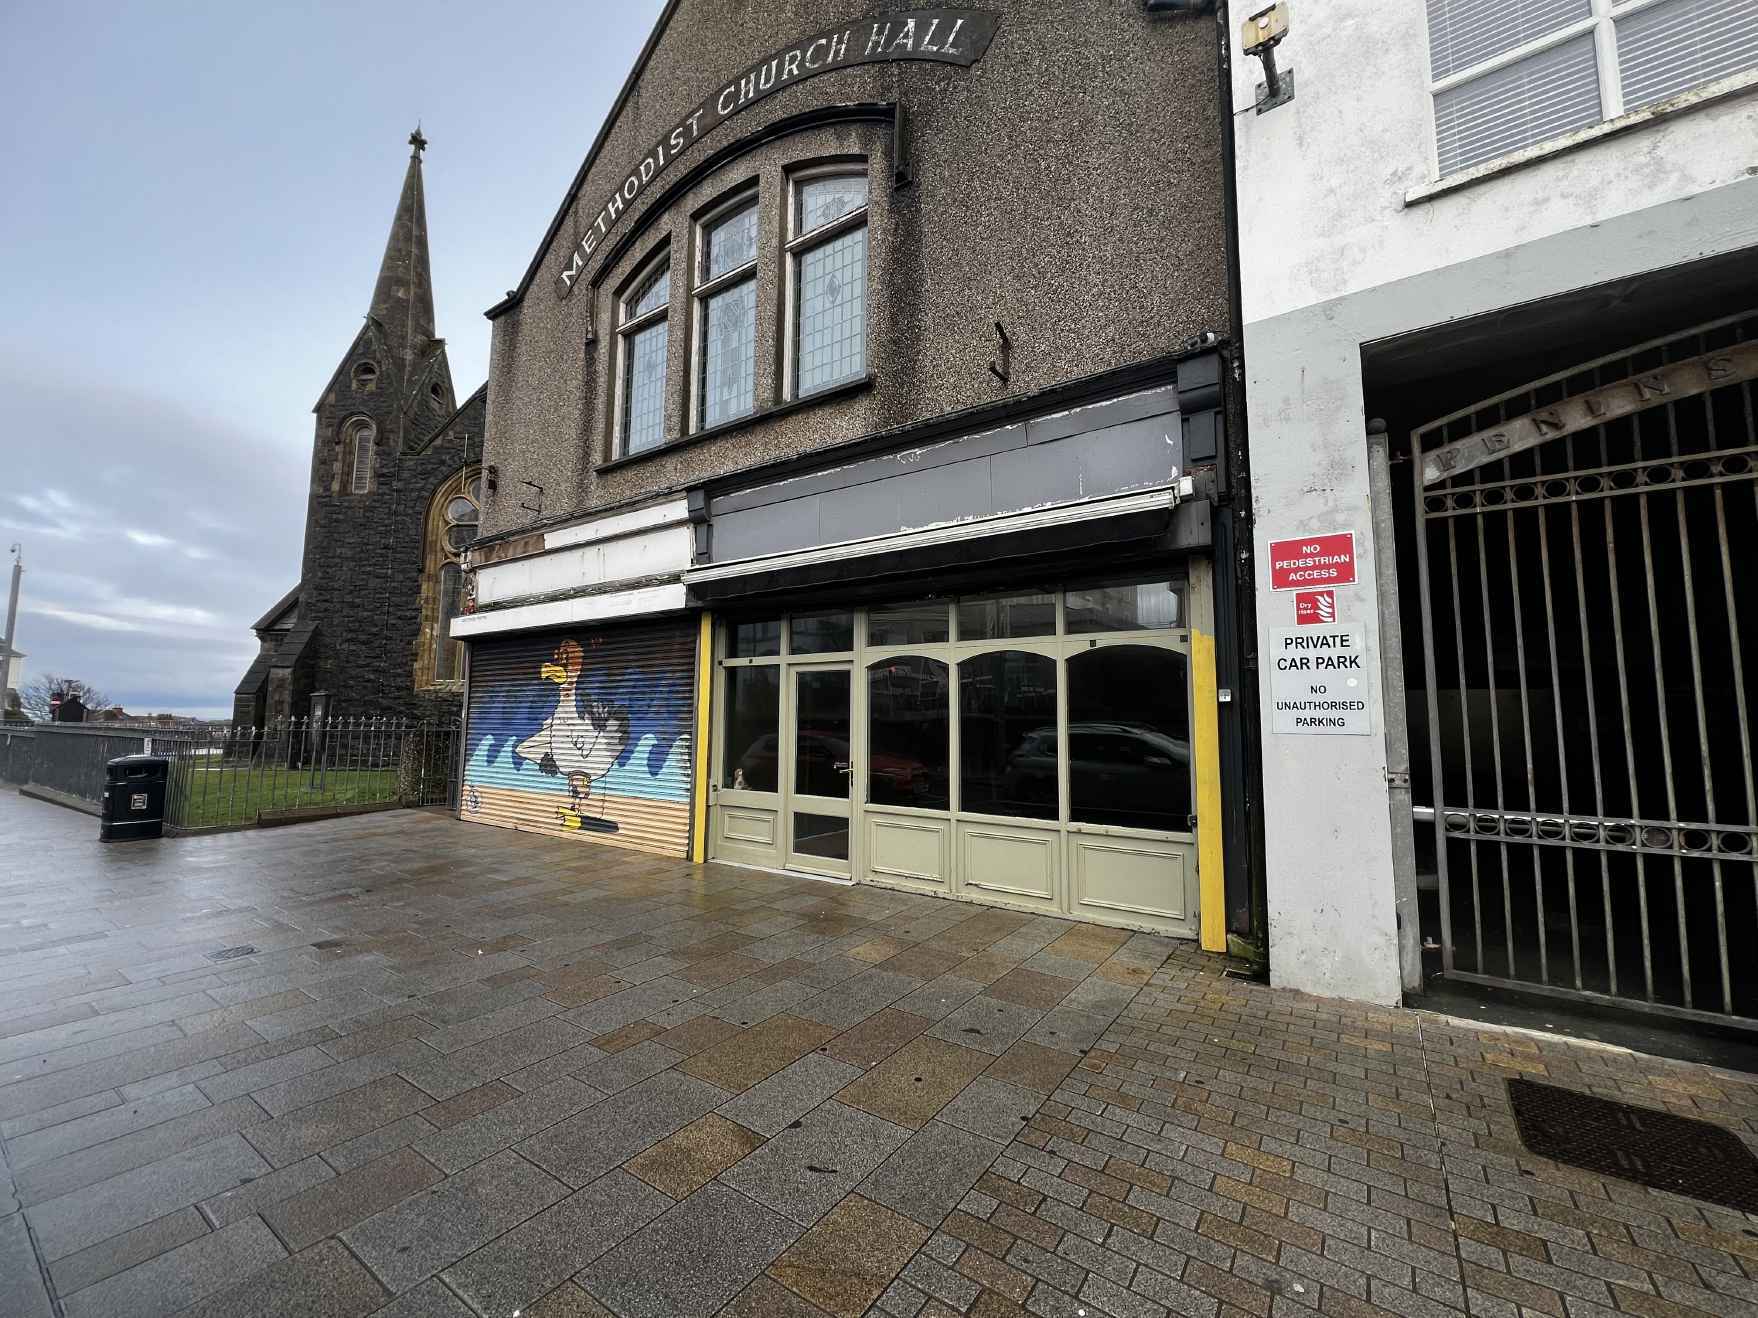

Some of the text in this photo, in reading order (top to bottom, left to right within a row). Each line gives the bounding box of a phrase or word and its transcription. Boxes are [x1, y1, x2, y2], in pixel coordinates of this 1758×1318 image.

[560, 18, 966, 286] METHODIST CHURCH HALL
[1302, 544, 1320, 554] NO
[1275, 555, 1350, 569] PEDESTRIAN
[1288, 569, 1338, 581] ACCESS
[1284, 634, 1350, 650] PRIVATE
[1277, 655, 1360, 671] CAR PARK
[1310, 685, 1327, 694] NO
[1276, 701, 1365, 711] UNAUTHORISED
[1295, 717, 1345, 727] PARKING
